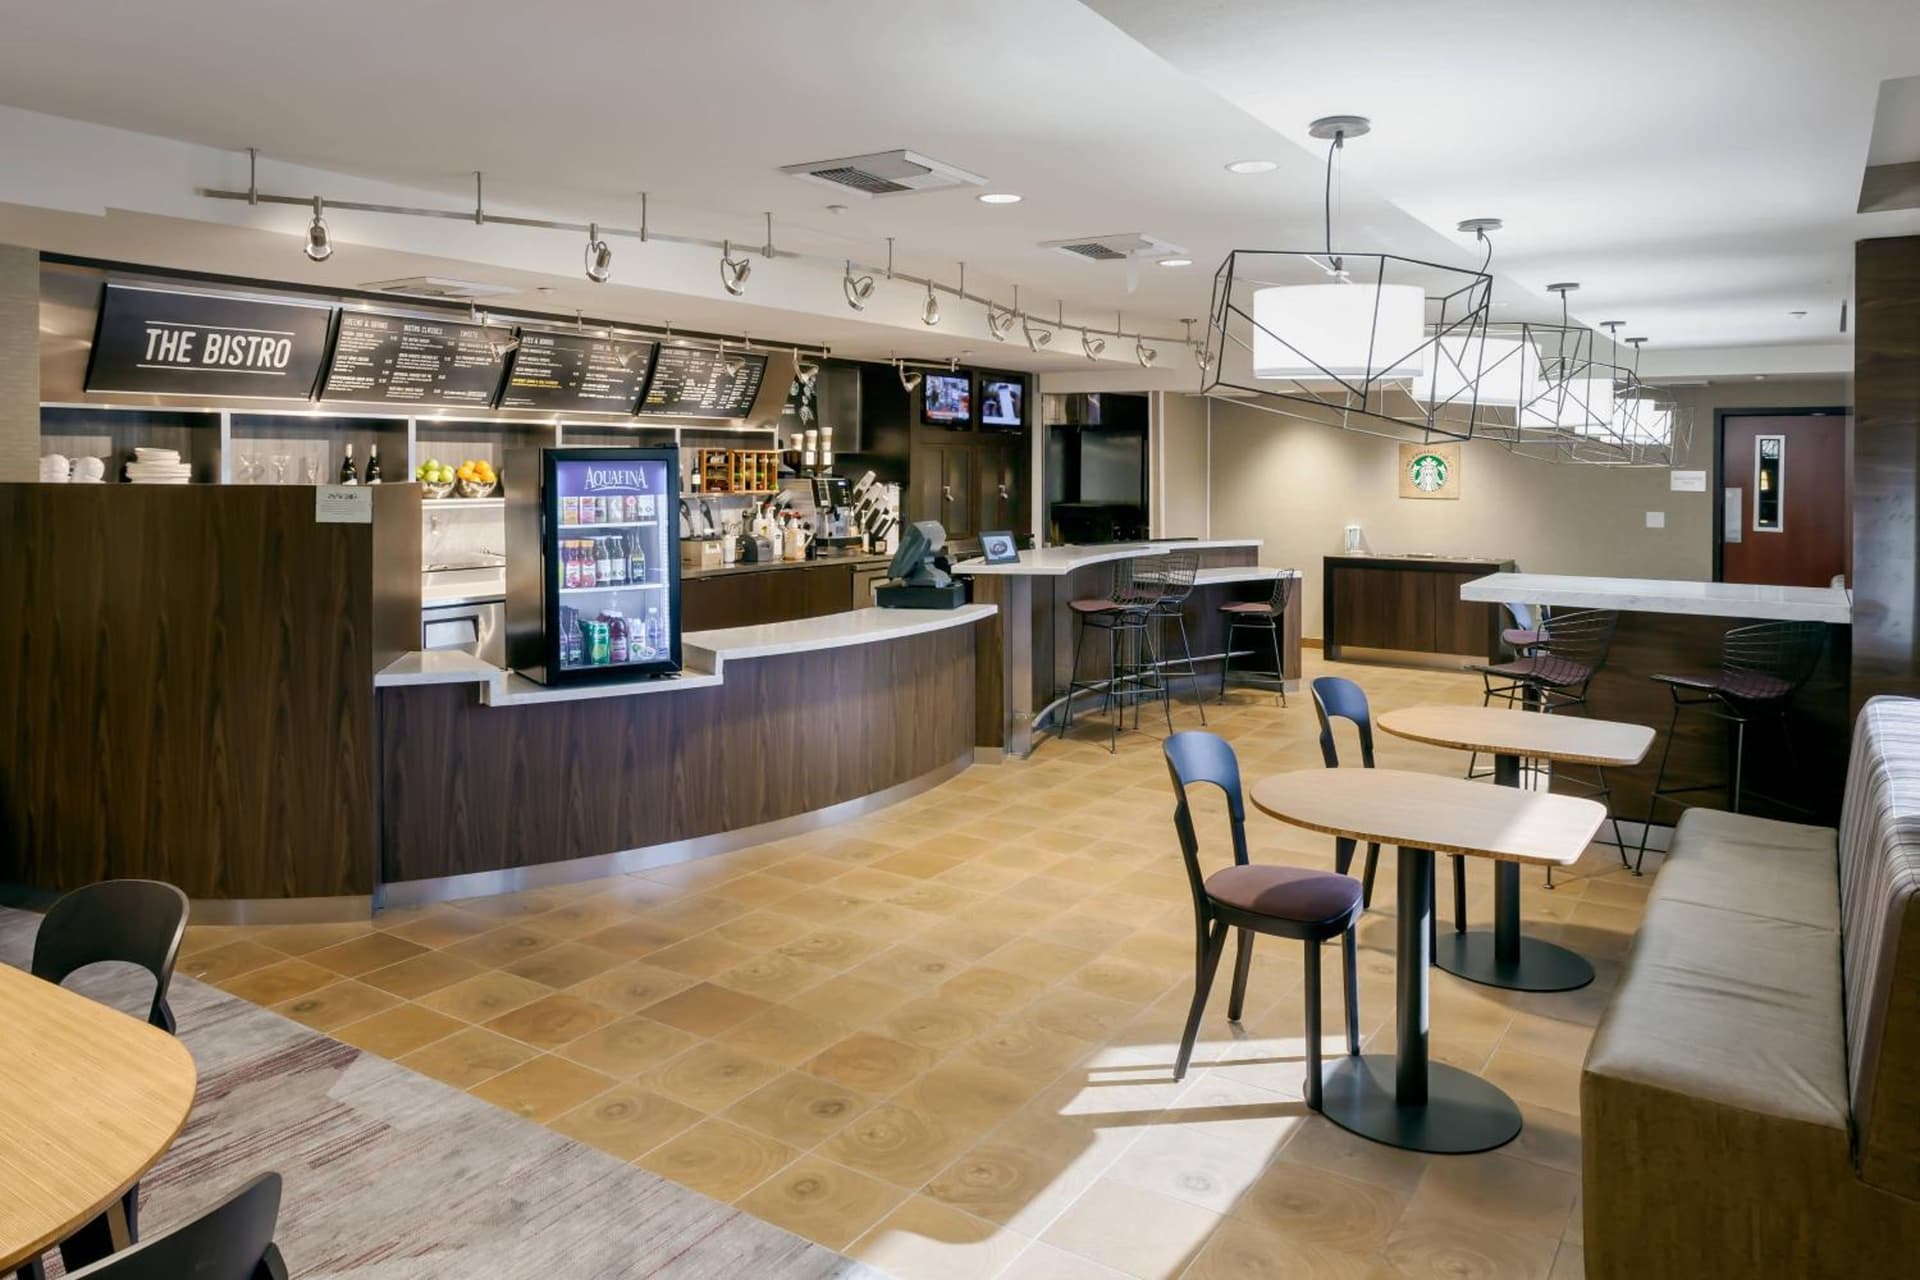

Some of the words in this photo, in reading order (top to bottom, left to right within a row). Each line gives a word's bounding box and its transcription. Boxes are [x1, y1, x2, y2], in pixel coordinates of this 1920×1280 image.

[145, 328, 196, 363] THE
[202, 336, 292, 369] BISTRO
[584, 465, 648, 489] AQUAFINA
